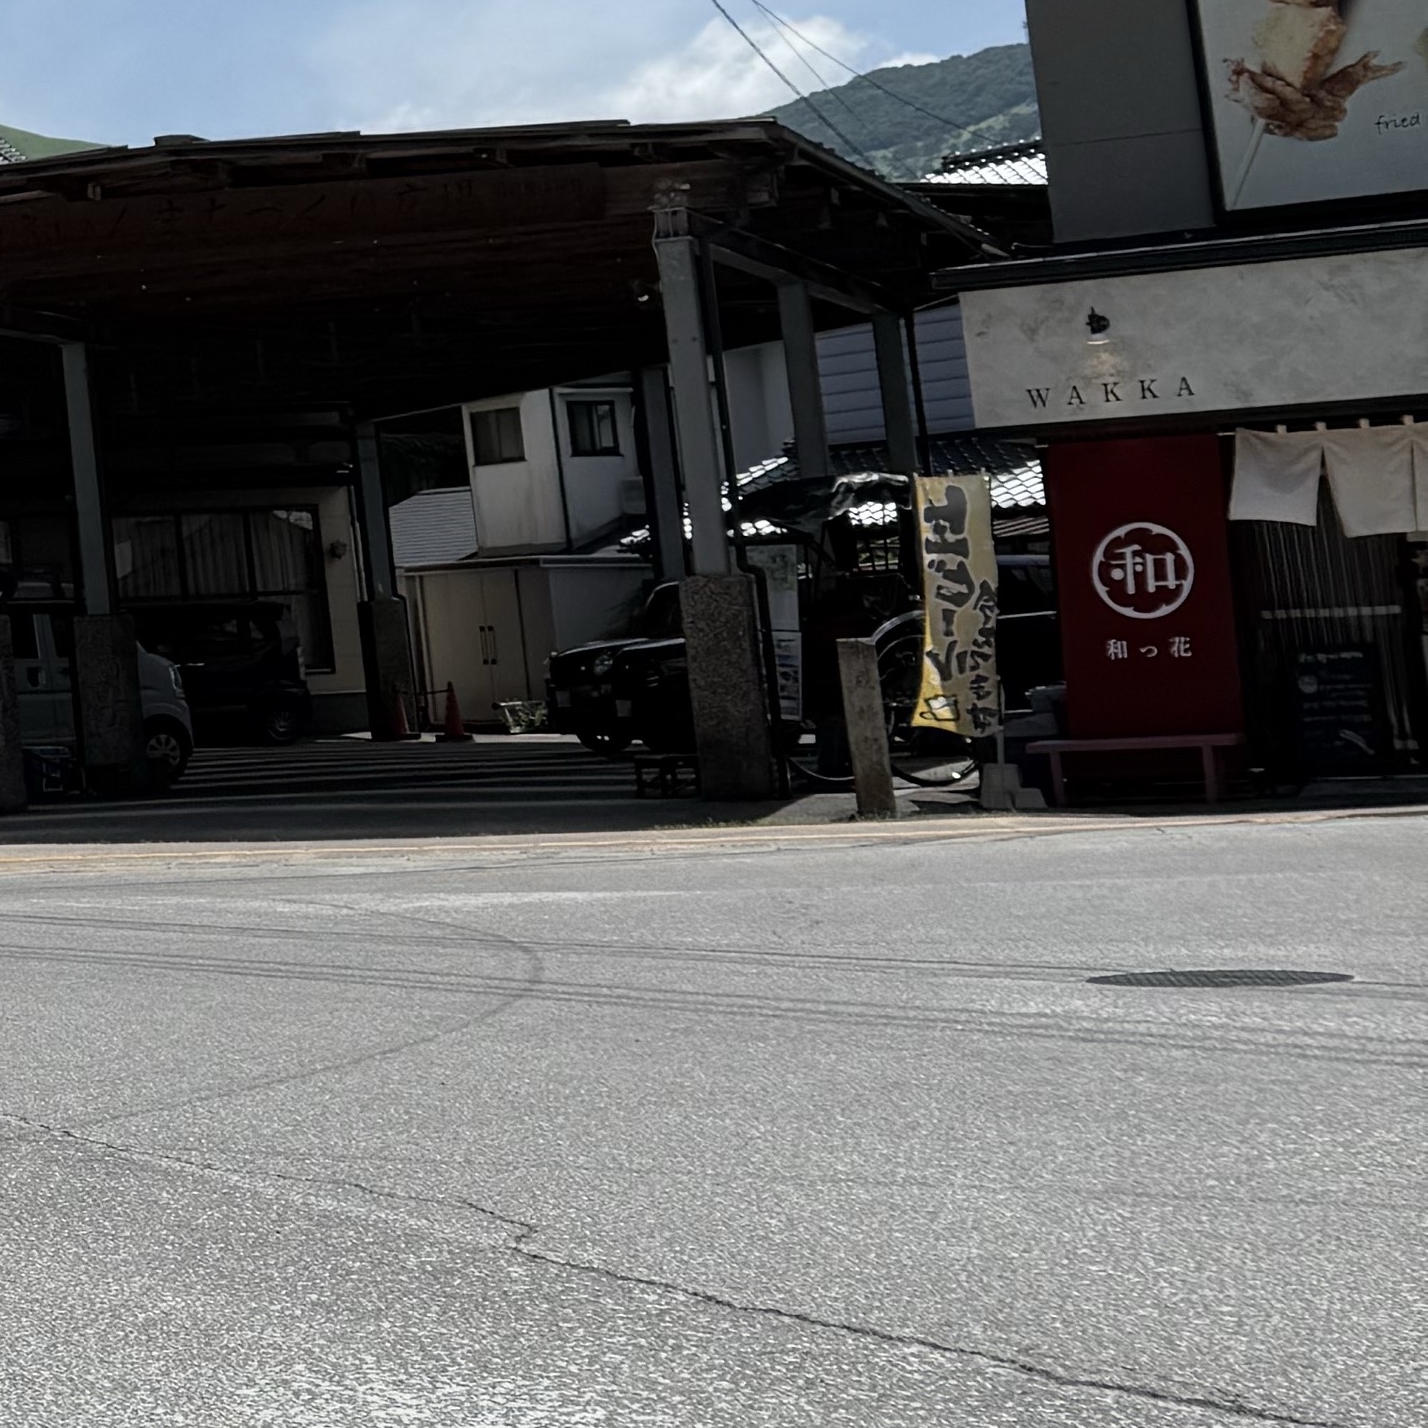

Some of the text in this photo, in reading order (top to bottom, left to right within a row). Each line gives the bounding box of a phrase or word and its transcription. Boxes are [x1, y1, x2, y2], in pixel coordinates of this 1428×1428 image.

[1374, 114, 1420, 135] fried
[1026, 375, 1196, 409] WAKKA
[1106, 636, 1193, 660] 和っ花
